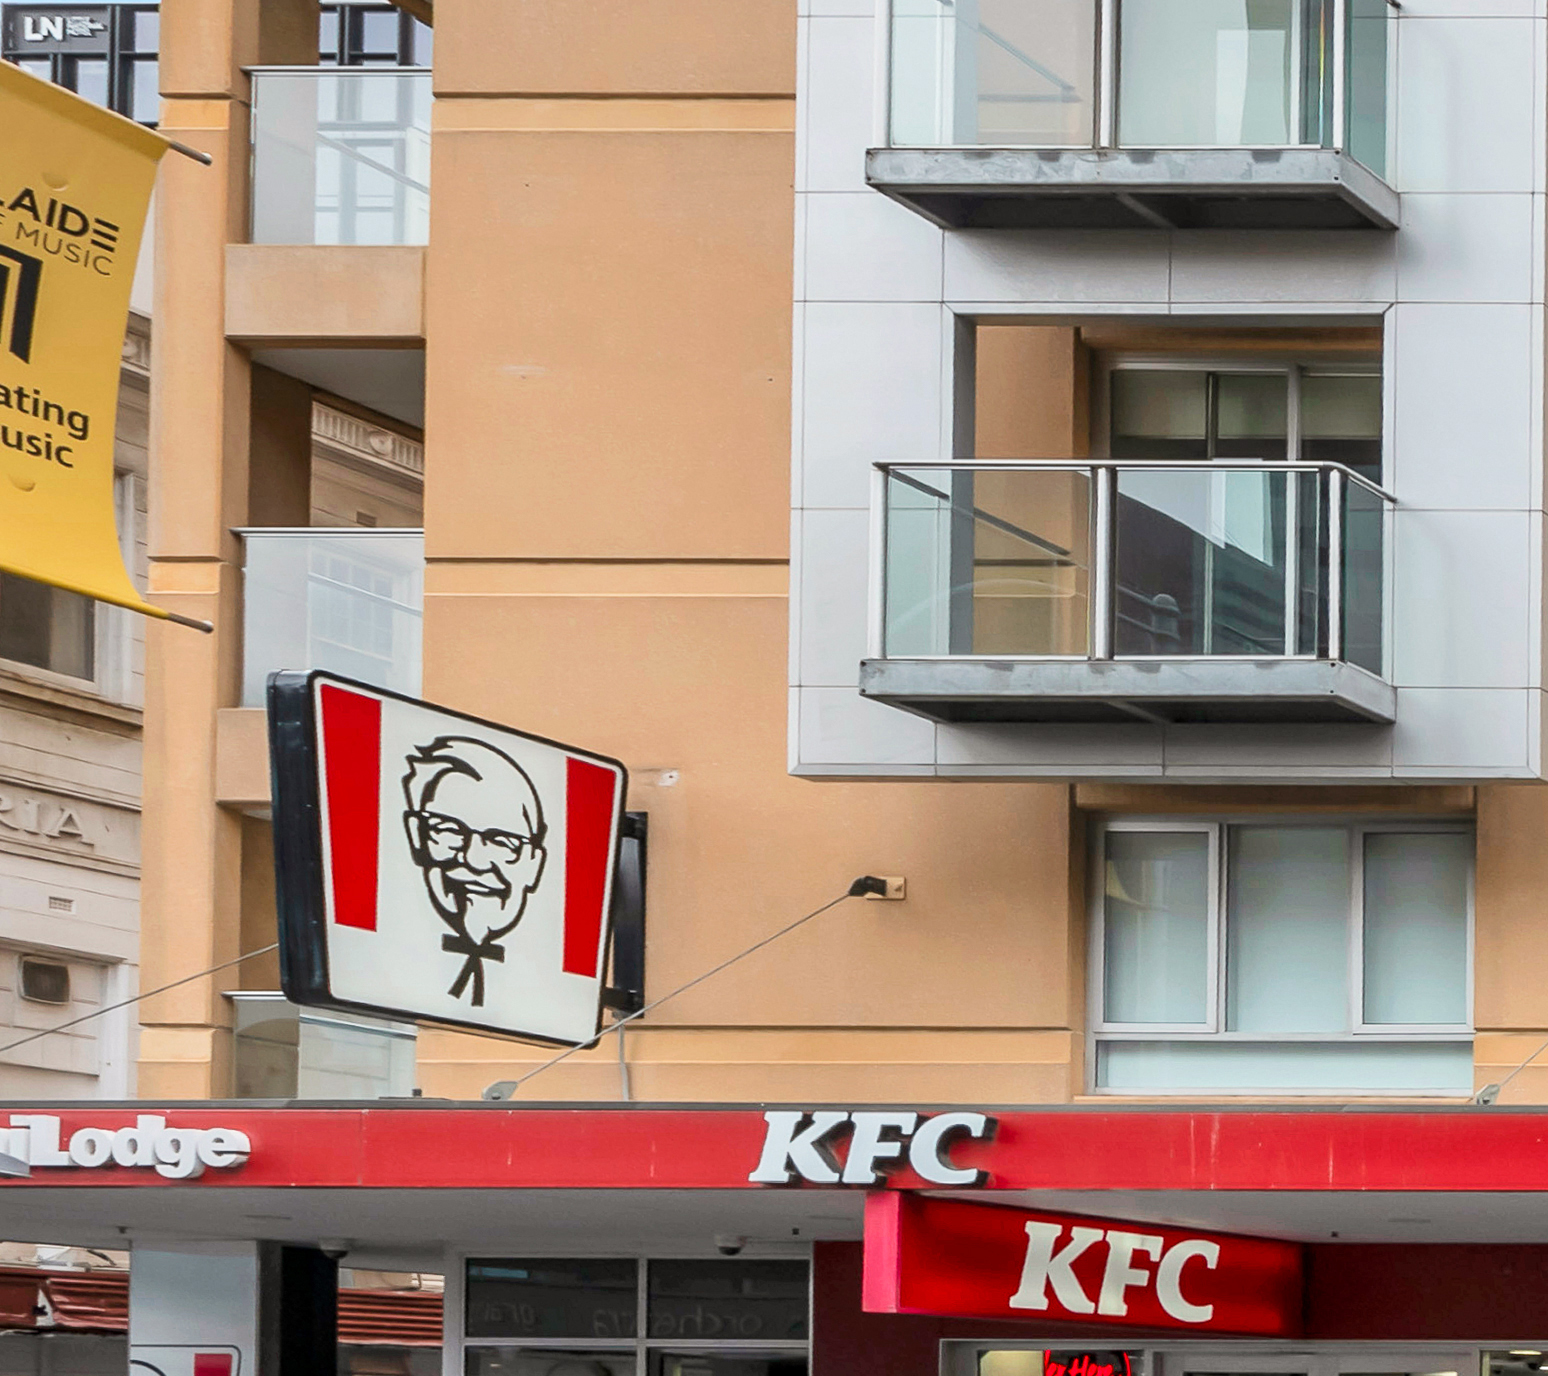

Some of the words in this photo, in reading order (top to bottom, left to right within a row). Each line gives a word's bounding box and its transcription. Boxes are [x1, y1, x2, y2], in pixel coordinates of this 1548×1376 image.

[15, 221, 113, 277] MUSIC
[748, 1110, 988, 1185] KFC
[1008, 1219, 1222, 1323] KFC
